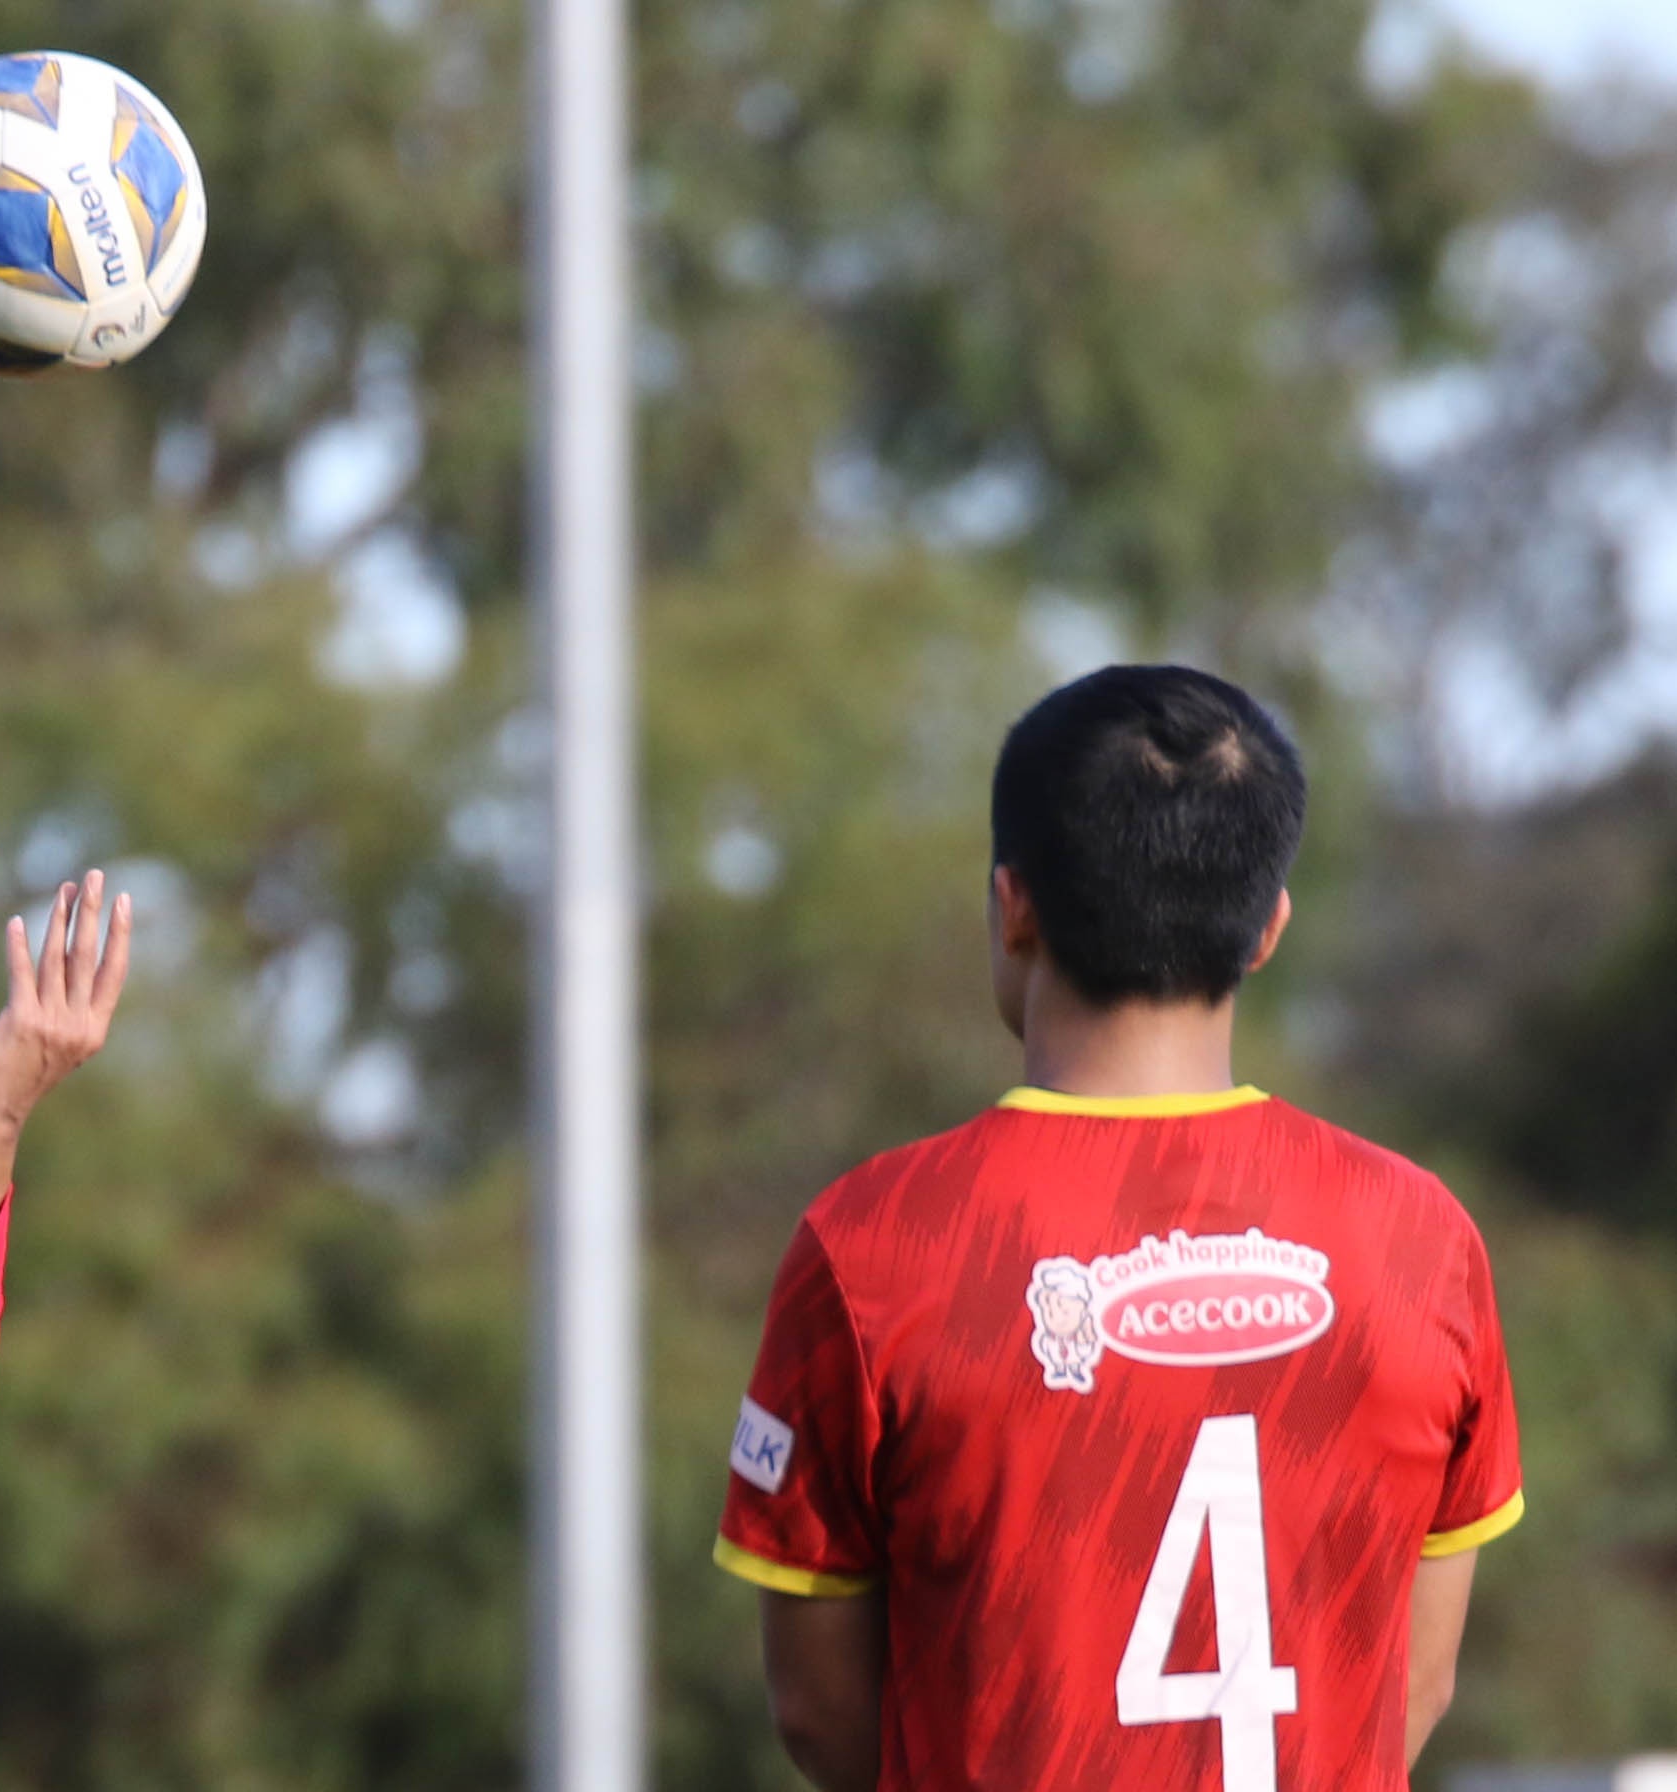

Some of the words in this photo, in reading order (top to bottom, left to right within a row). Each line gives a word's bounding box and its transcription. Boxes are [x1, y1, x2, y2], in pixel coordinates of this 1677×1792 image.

[67, 161, 128, 289] molten
[1095, 1245, 1168, 1287] Cook
[1177, 1234, 1323, 1275] happiness
